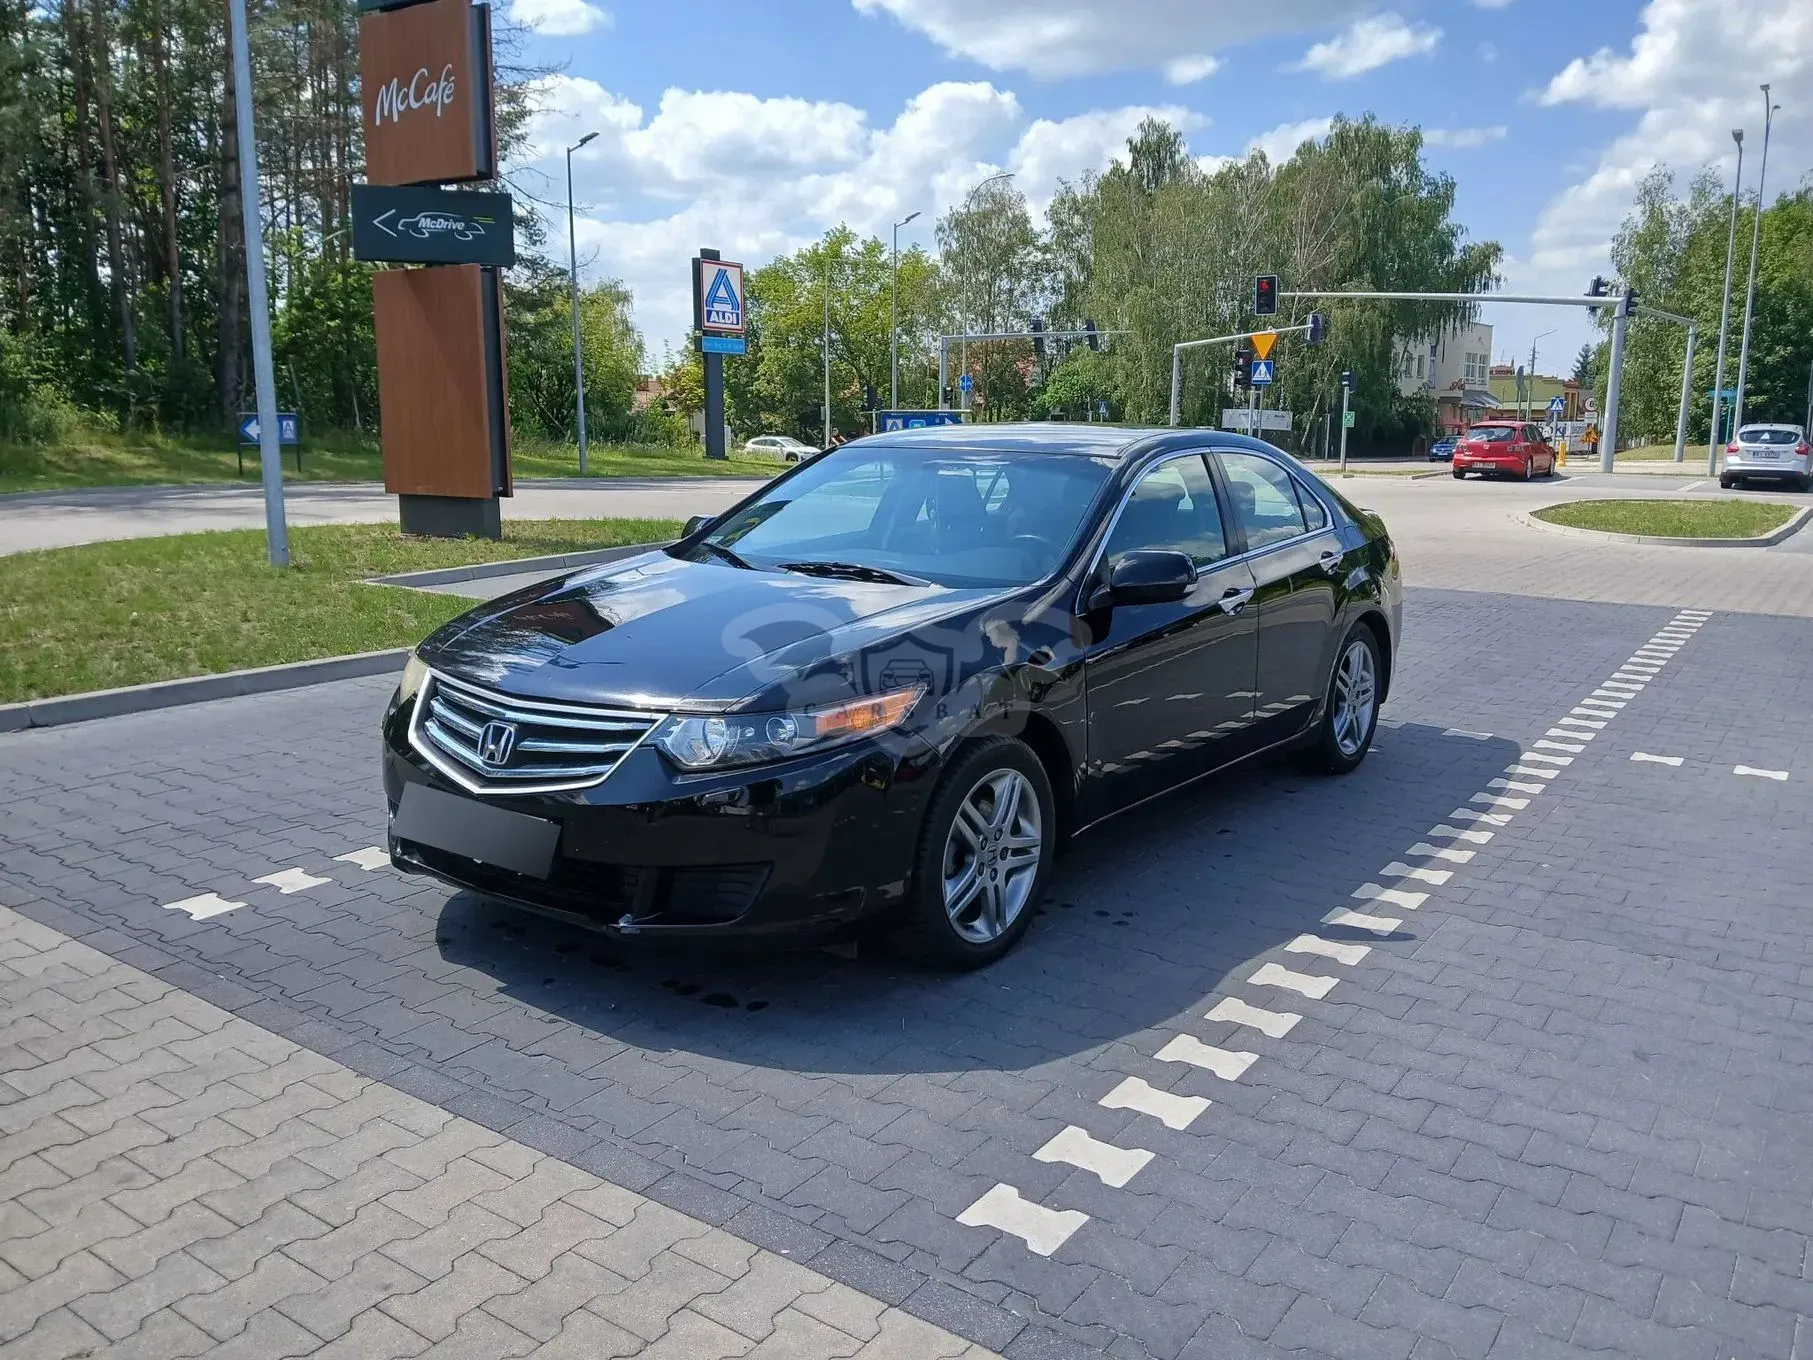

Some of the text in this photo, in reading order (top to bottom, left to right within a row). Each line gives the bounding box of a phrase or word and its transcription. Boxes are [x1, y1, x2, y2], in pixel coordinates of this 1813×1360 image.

[375, 63, 455, 126] McCafé
[418, 217, 465, 230] McDrive
[709, 310, 737, 324] ALDI
